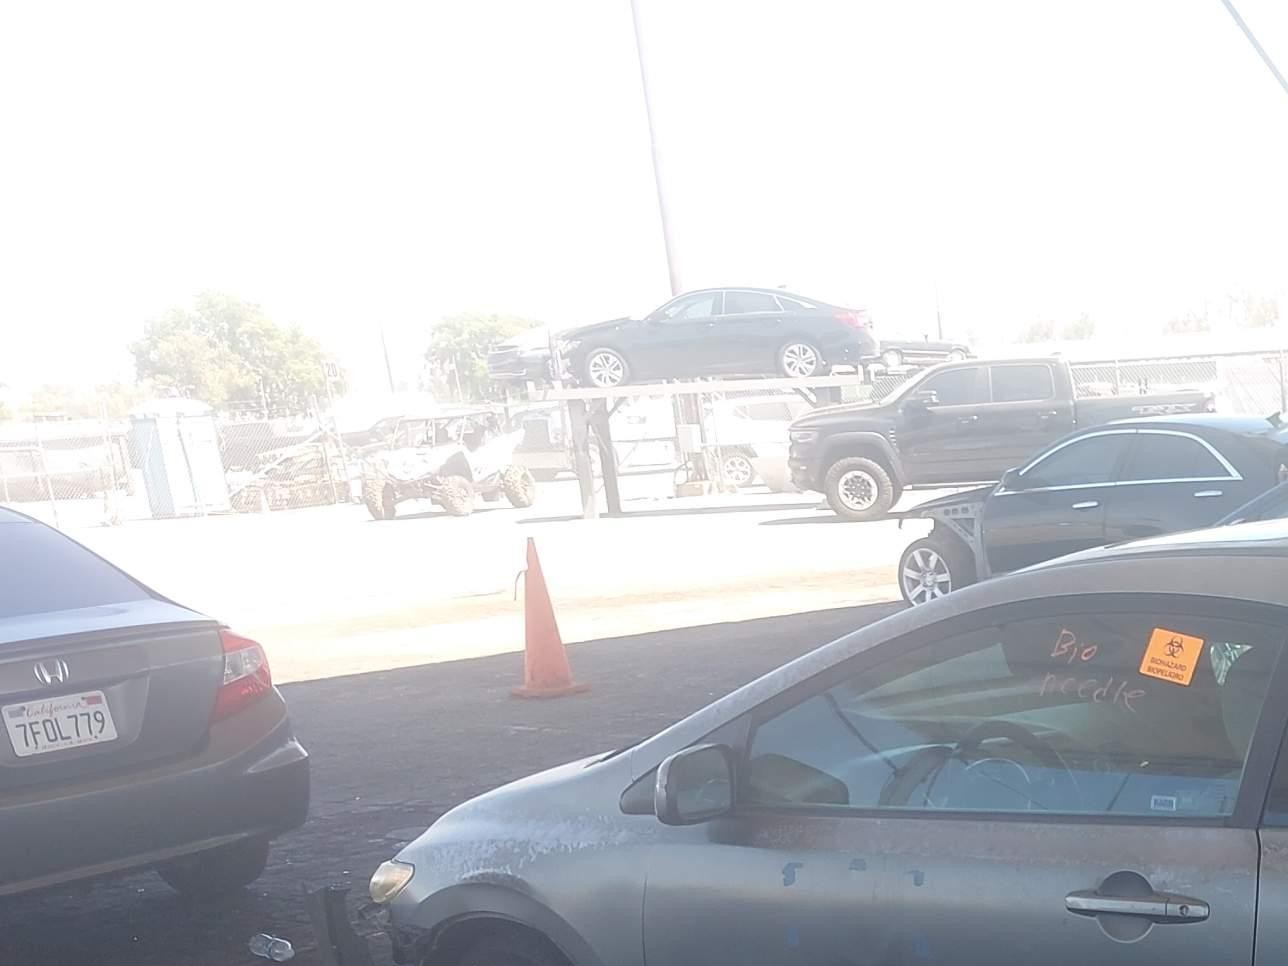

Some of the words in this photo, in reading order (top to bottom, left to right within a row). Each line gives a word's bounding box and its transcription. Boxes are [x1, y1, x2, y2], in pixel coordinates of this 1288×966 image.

[1050, 629, 1098, 664] Bio
[1150, 656, 1187, 672] BIOHAZARD
[26, 702, 81, 718] California
